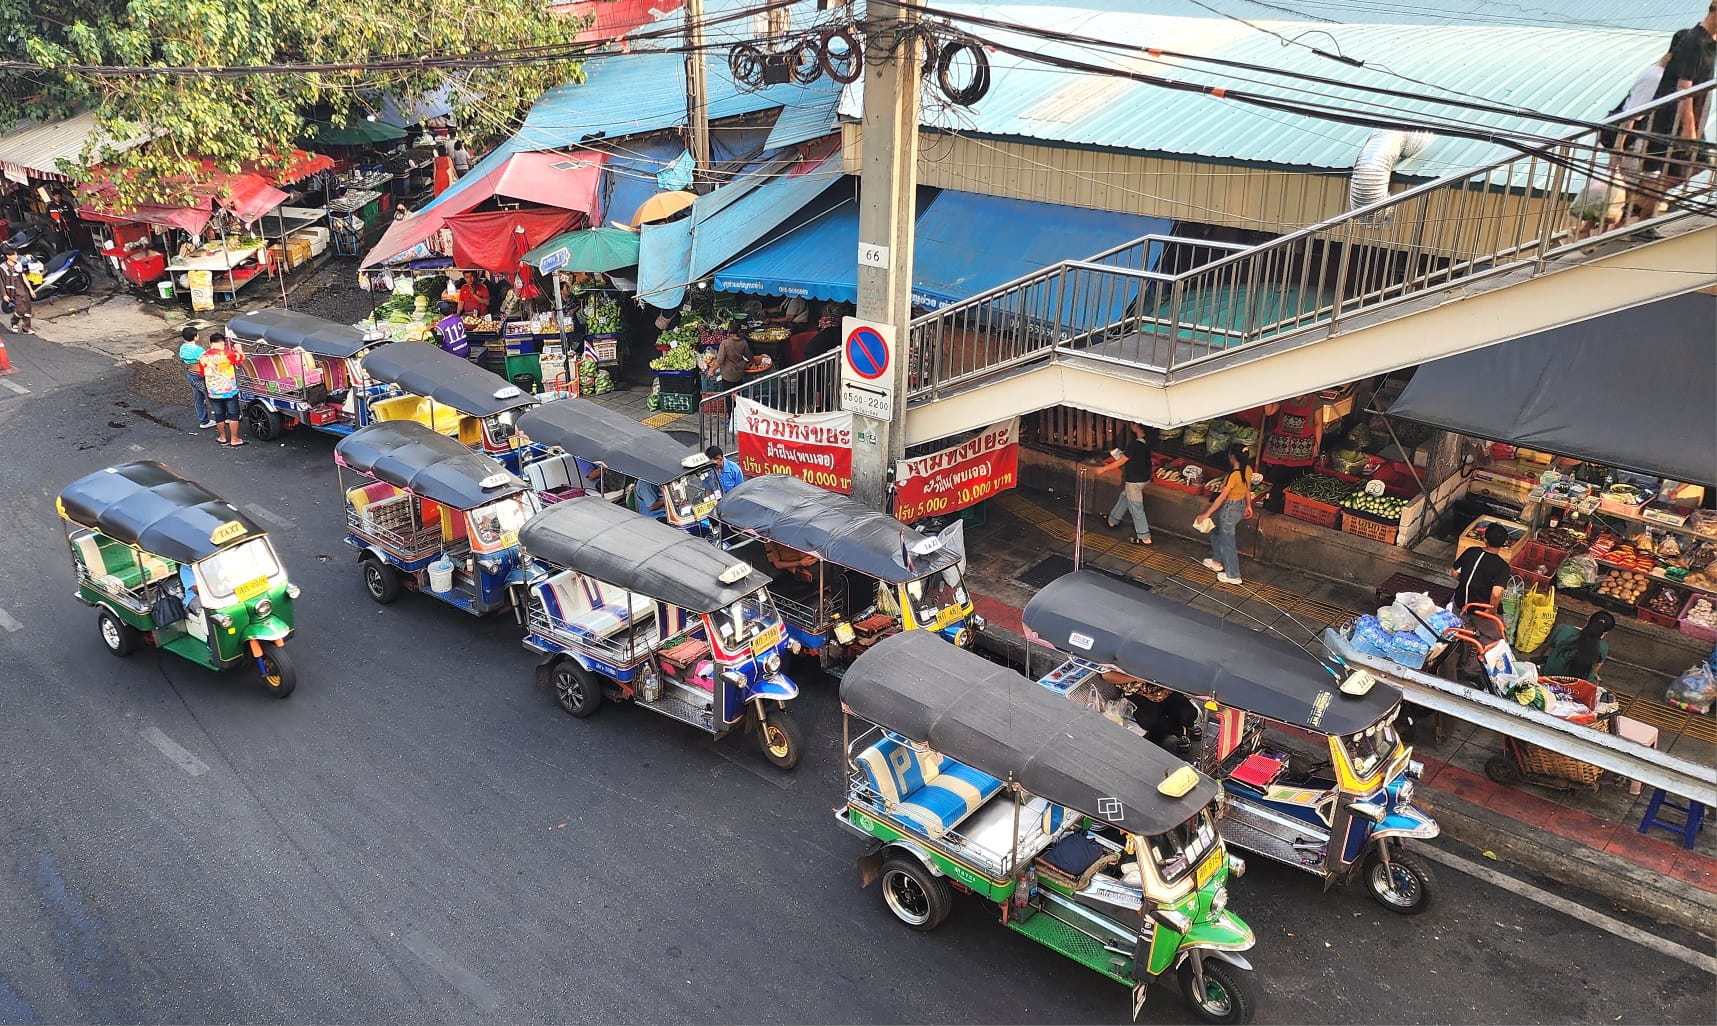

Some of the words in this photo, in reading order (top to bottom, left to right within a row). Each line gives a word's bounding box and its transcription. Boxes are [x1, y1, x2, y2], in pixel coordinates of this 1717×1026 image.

[866, 251, 880, 262] 66
[445, 321, 467, 344] 112
[746, 407, 851, 445] ห้ามทิ้งขยะ
[743, 456, 761, 474] ปรับ
[917, 497, 948, 517] 5,000
[957, 482, 991, 505] 10,000
[993, 472, 1012, 490] บาท
[218, 523, 240, 538] TAXI
